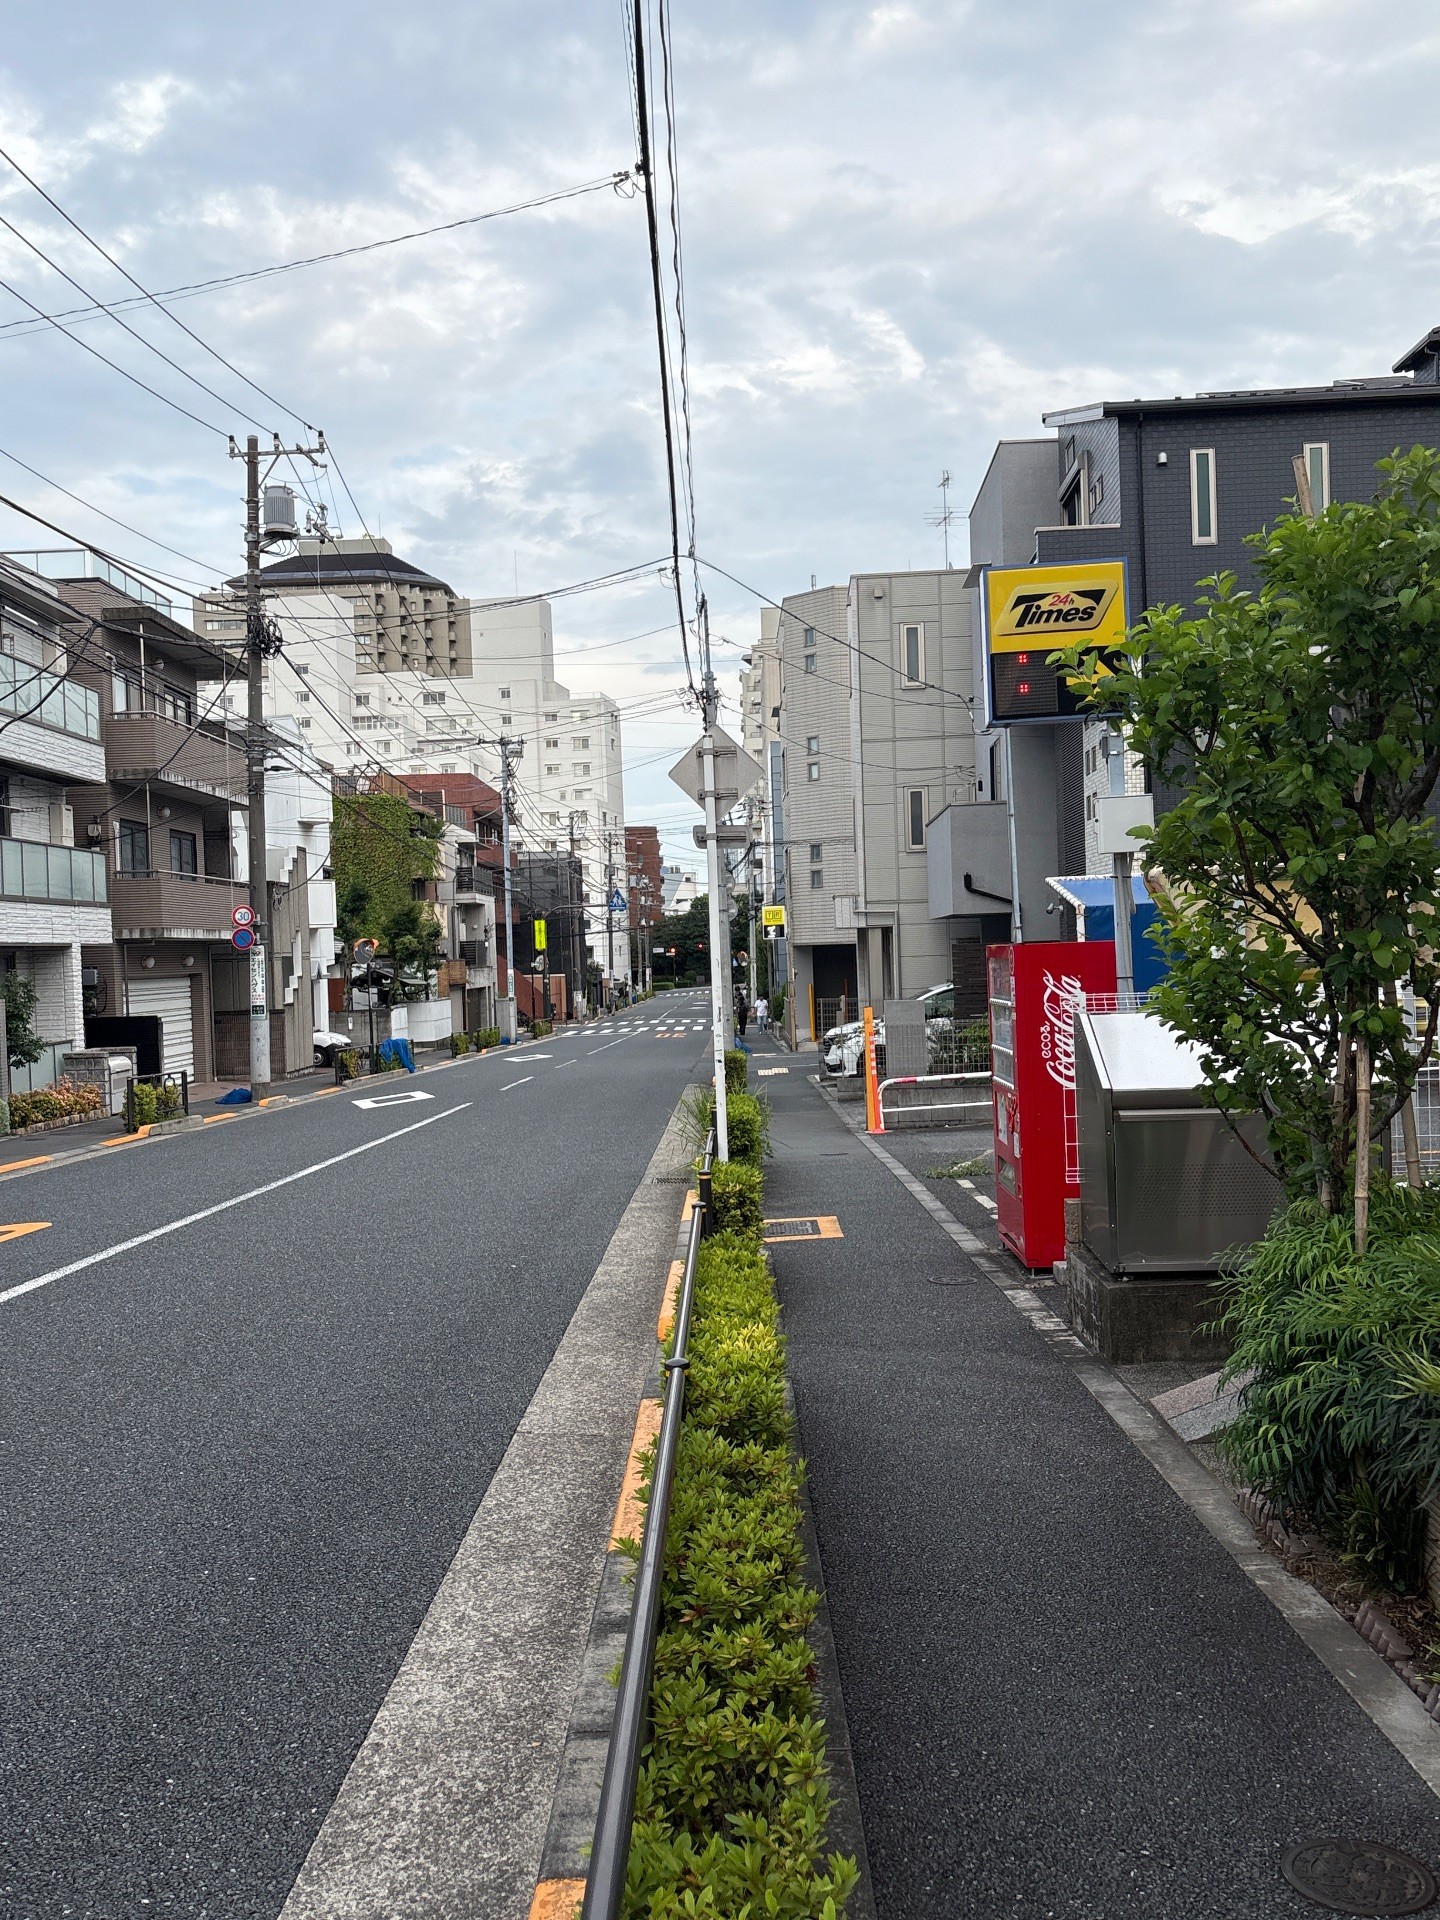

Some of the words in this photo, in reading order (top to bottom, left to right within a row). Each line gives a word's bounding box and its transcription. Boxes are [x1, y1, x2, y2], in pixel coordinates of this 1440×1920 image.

[1010, 593, 1097, 628] Times
[1048, 593, 1075, 606] 24h
[237, 912, 250, 921] 30
[1043, 968, 1081, 1089] Coca-Cola
